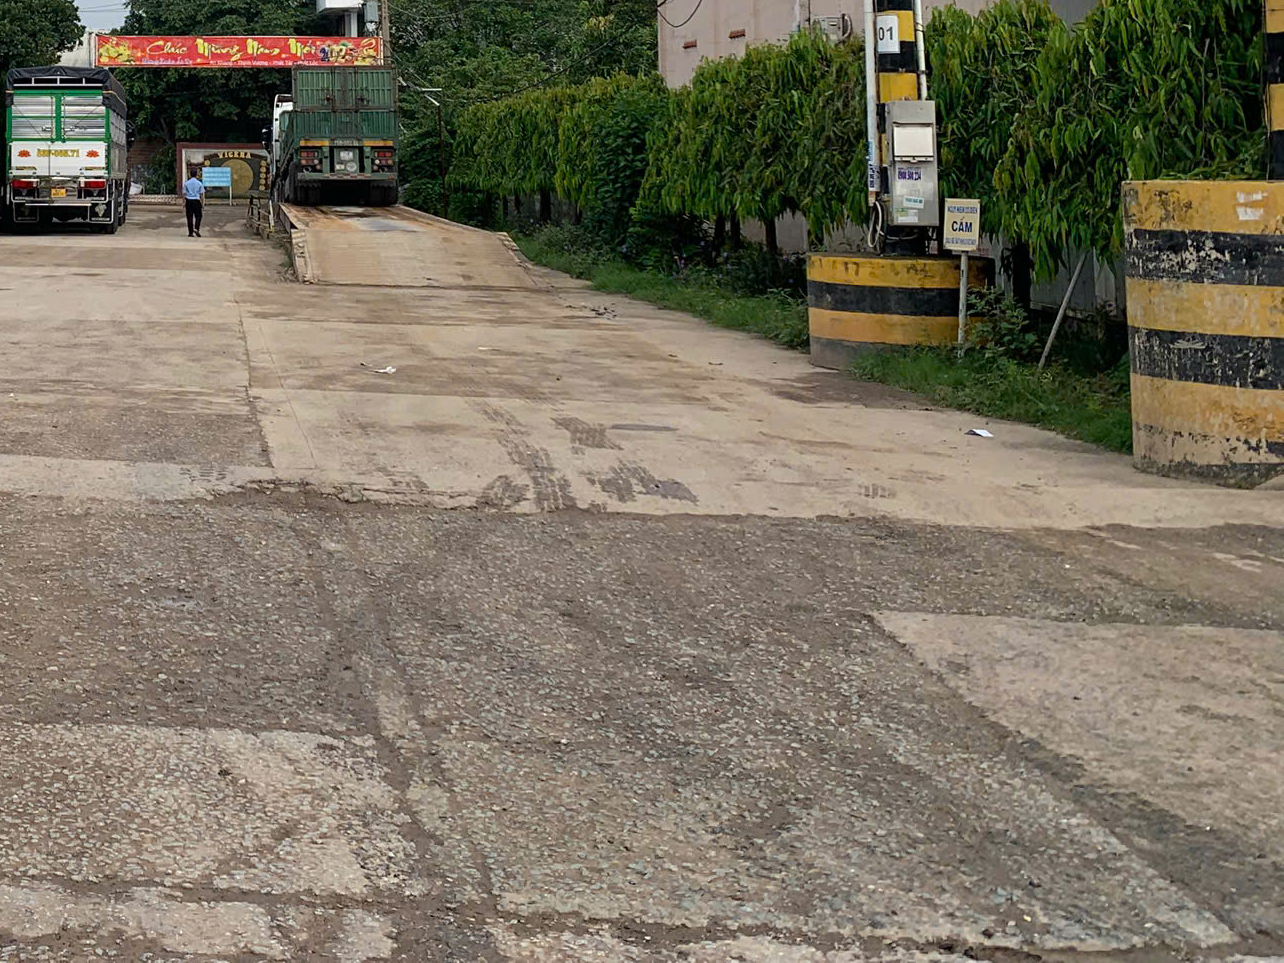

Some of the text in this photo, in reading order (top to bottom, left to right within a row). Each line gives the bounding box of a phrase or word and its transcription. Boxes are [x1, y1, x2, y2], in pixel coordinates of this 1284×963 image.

[878, 26, 893, 41] 01
[146, 40, 189, 55] Chúc
[195, 38, 245, 62] Mừng
[288, 38, 316, 60] Mới
[319, 44, 356, 63] 2025
